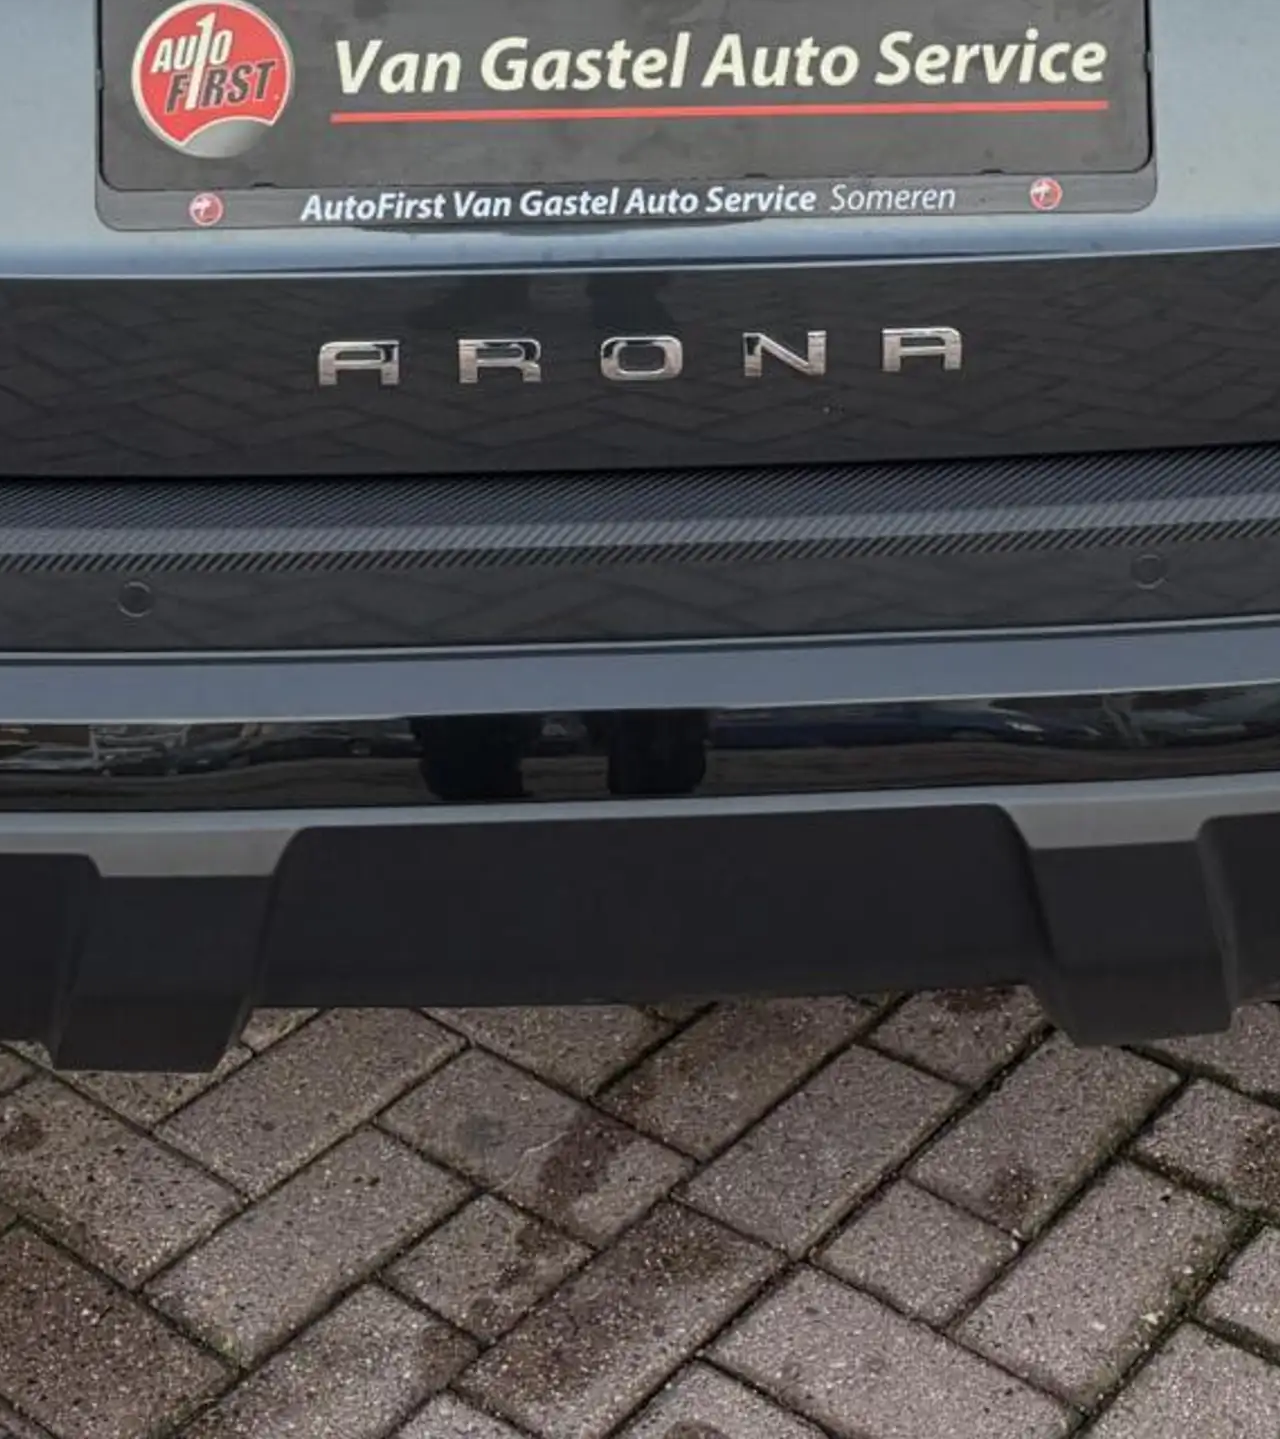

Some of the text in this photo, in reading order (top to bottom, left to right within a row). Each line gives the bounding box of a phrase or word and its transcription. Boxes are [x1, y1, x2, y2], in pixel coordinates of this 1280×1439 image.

[335, 27, 1108, 94] Van Gastel Auto Service
[300, 183, 956, 222] AutoFirst Van Gastel Auto Service Someren
[319, 327, 962, 386] ARONA
